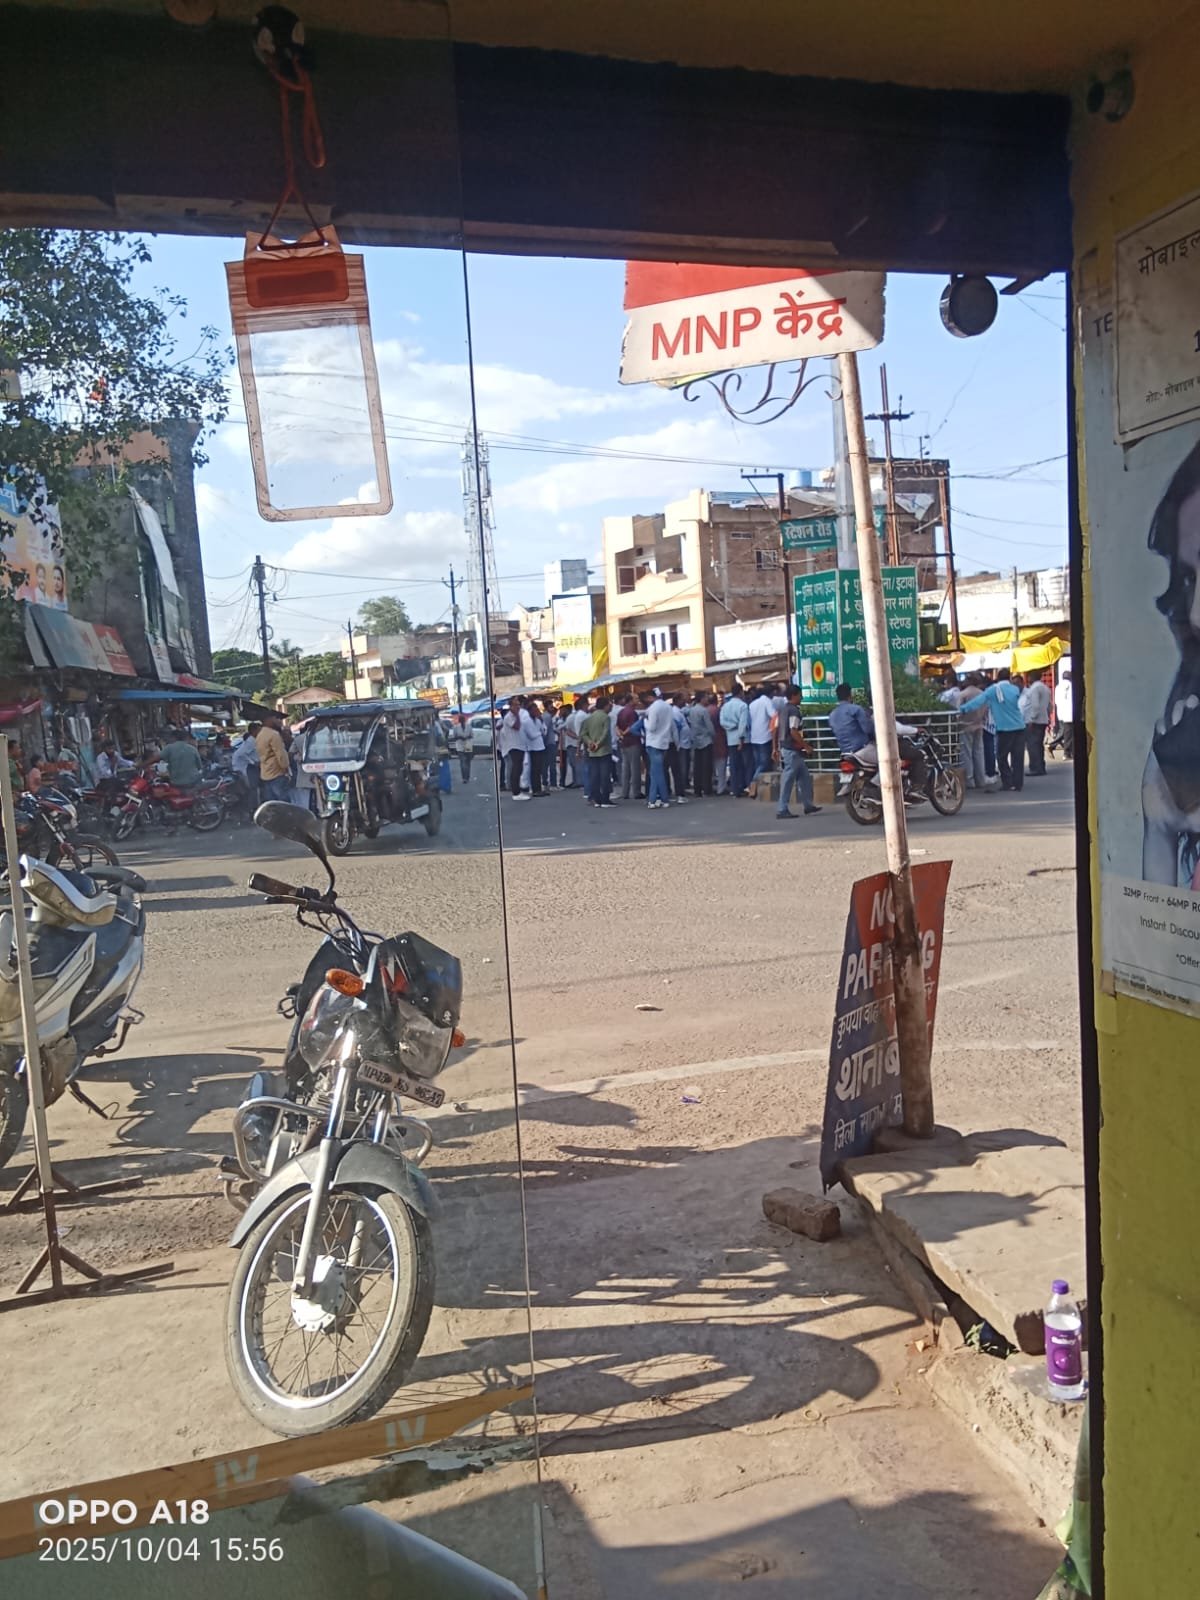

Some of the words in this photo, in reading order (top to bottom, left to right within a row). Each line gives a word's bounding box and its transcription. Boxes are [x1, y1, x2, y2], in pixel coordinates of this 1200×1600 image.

[652, 307, 762, 361] MNP
[773, 290, 847, 341] केंद्र
[784, 522, 815, 540] स्टेशन
[899, 596, 913, 610] मार्ग
[891, 634, 915, 651] स्टेशन
[1143, 892, 1160, 904] Front
[1166, 896, 1190, 910] 64MP
[1140, 915, 1167, 931] Instant
[1169, 922, 1200, 941] Discou
[1176, 952, 1200, 969] Offer
[837, 1006, 862, 1050] कृपया
[834, 1039, 884, 1101] थाना
[833, 1117, 857, 1153] जिला
